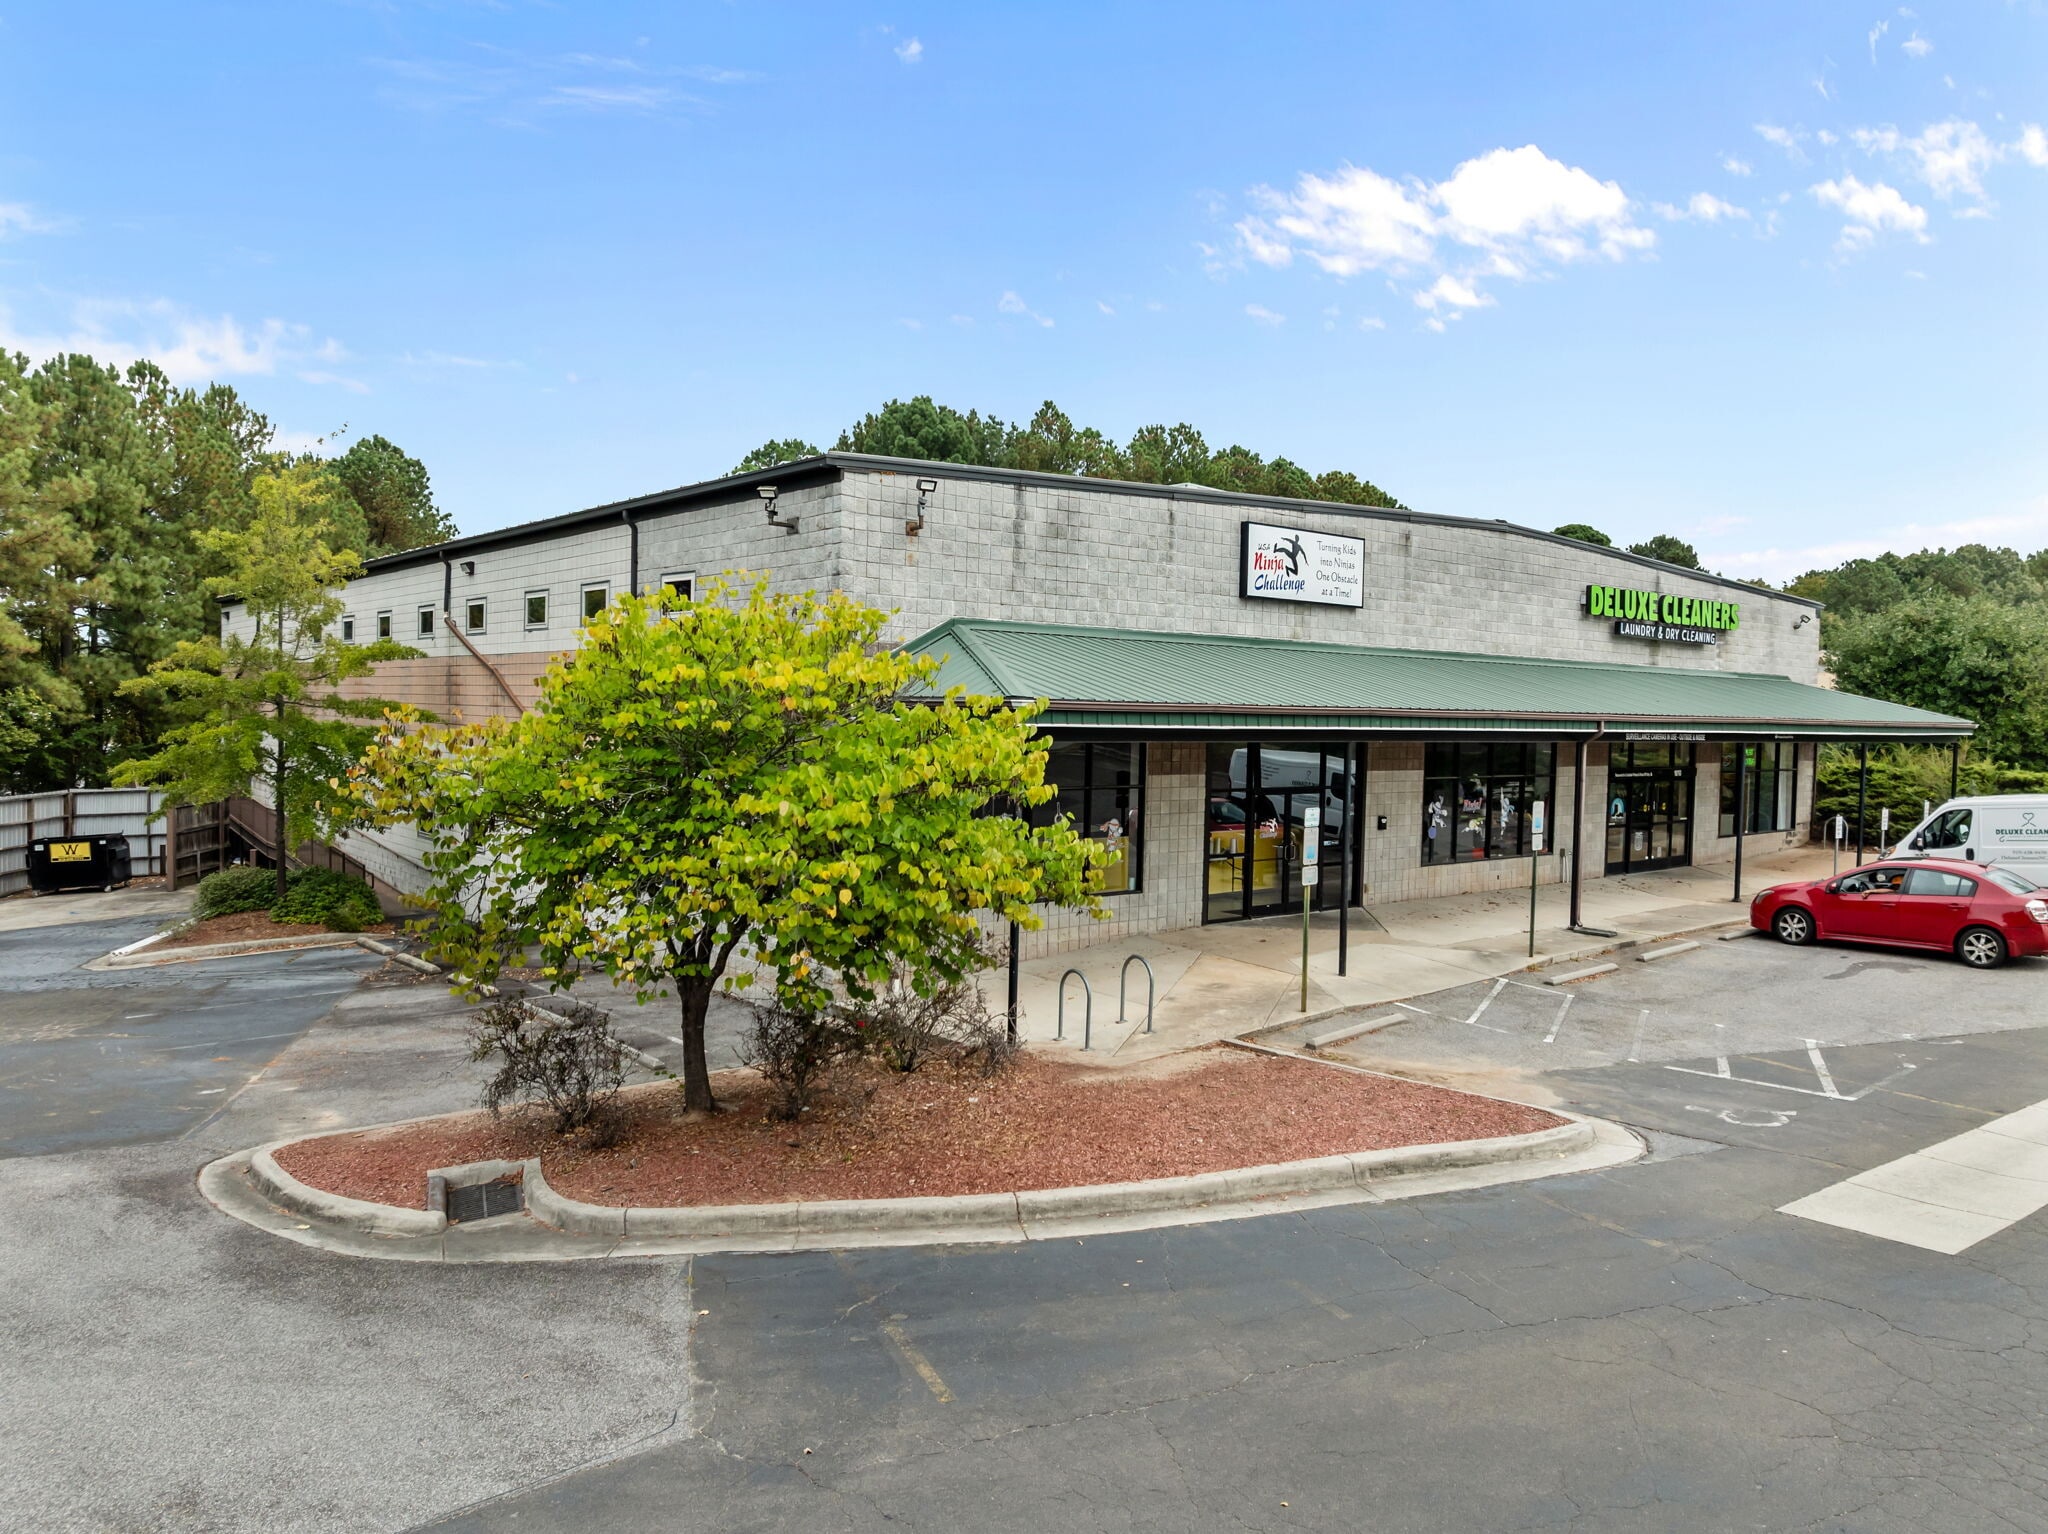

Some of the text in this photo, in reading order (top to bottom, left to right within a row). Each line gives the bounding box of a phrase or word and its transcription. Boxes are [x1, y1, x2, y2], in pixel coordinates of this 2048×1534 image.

[1316, 540, 1357, 556] Turning Kids
[1254, 551, 1284, 575] Ninja
[1320, 557, 1355, 571] into Ninjas
[1254, 574, 1305, 594] Challenge
[1316, 570, 1358, 585] One Obstacle
[1590, 584, 1741, 631] DELUXE CLEANERS
[1620, 622, 1716, 645] LAUNDRY & DRY CLEANING
